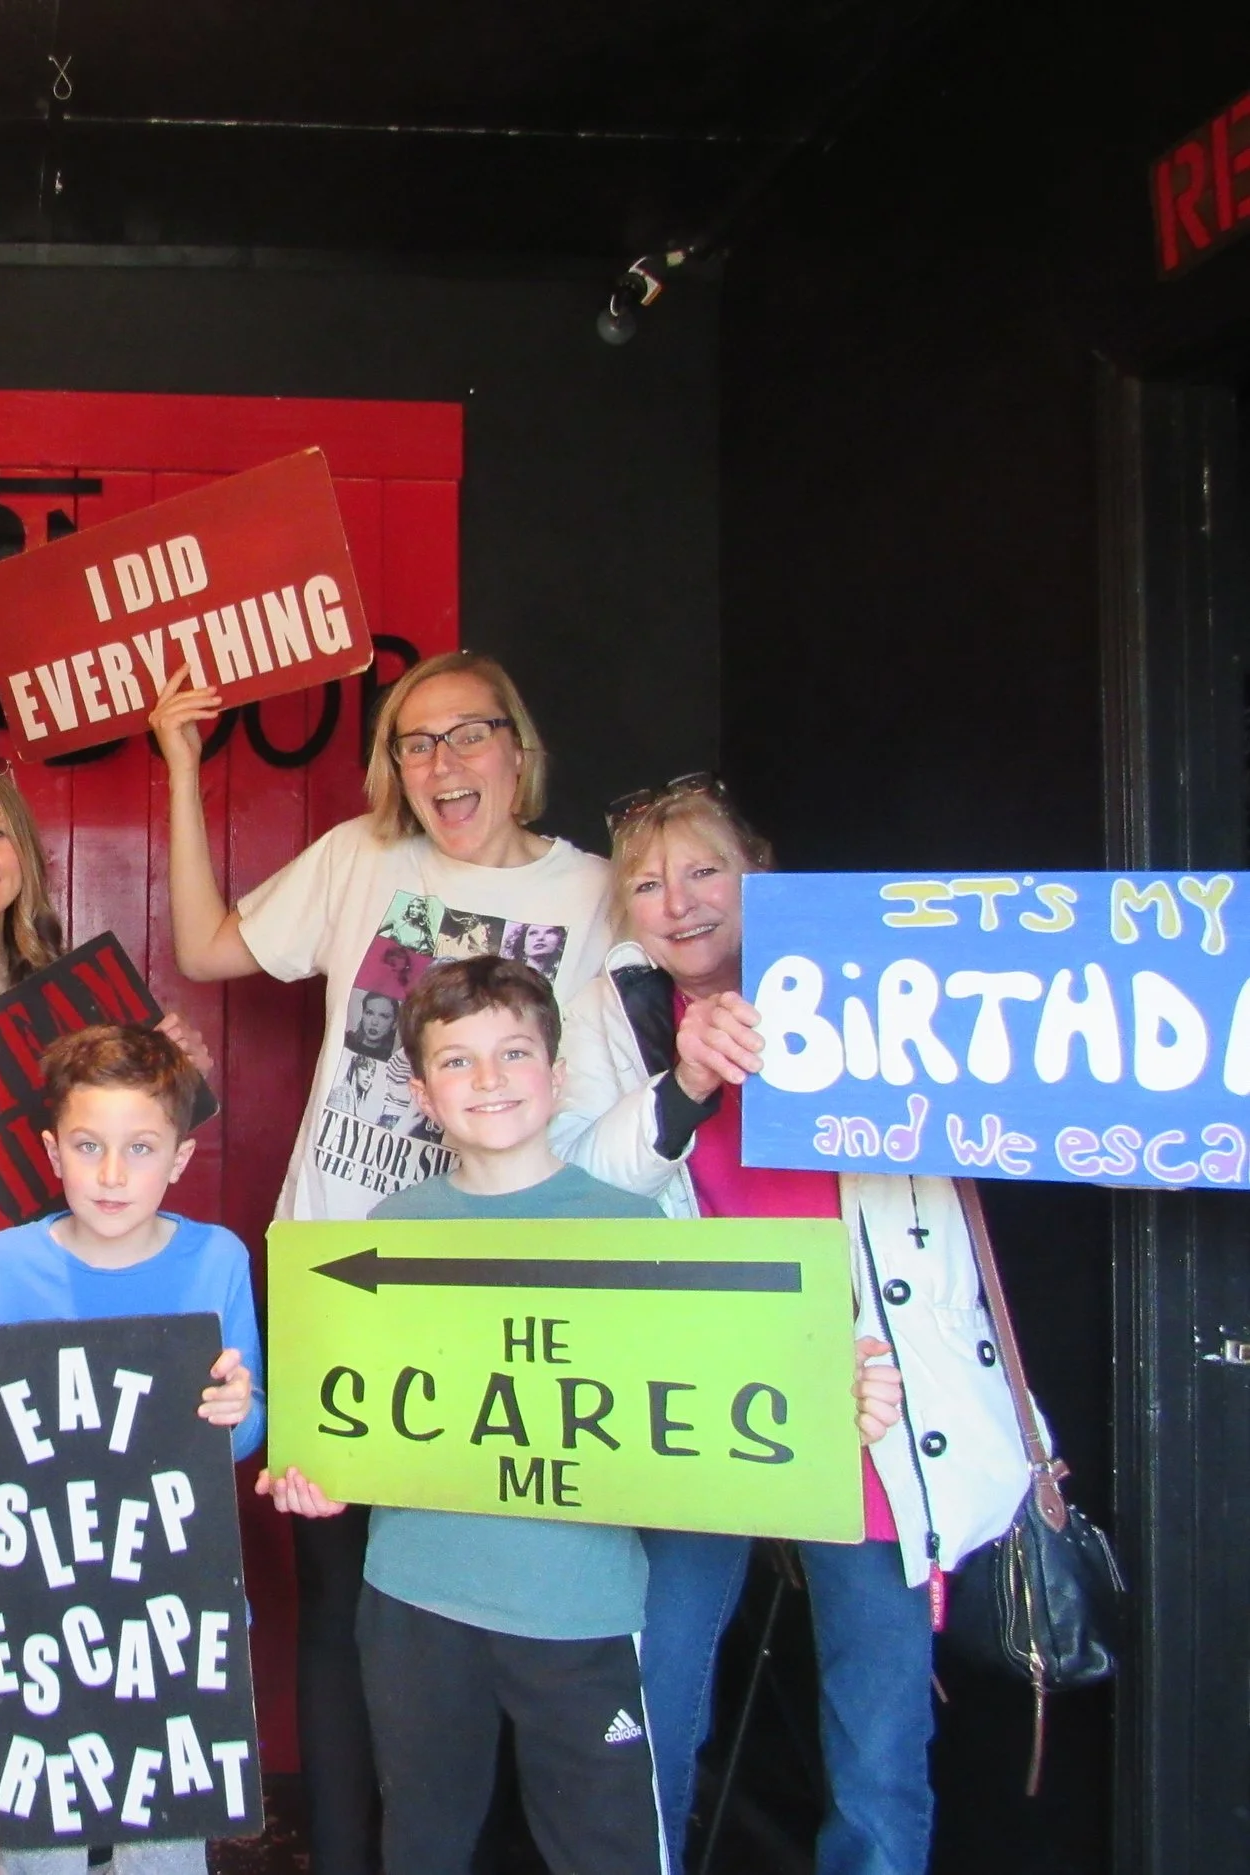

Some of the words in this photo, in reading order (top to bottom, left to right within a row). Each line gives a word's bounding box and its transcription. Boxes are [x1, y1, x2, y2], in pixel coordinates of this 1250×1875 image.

[85, 566, 111, 623] I
[113, 535, 209, 613] DID
[9, 575, 352, 743] EVERYTHING
[880, 877, 1079, 934] IT'S
[1110, 875, 1234, 956] MY
[315, 1147, 356, 1181] THE
[316, 1108, 412, 1179] TAYLOR
[813, 1094, 929, 1162] and
[1055, 1122, 1249, 1183] esca
[503, 1316, 572, 1364] HE
[0, 1347, 153, 1465] EAT
[318, 1365, 795, 1465] SCARES
[499, 1456, 582, 1507] ME
[604, 1725, 642, 1743] adidas
